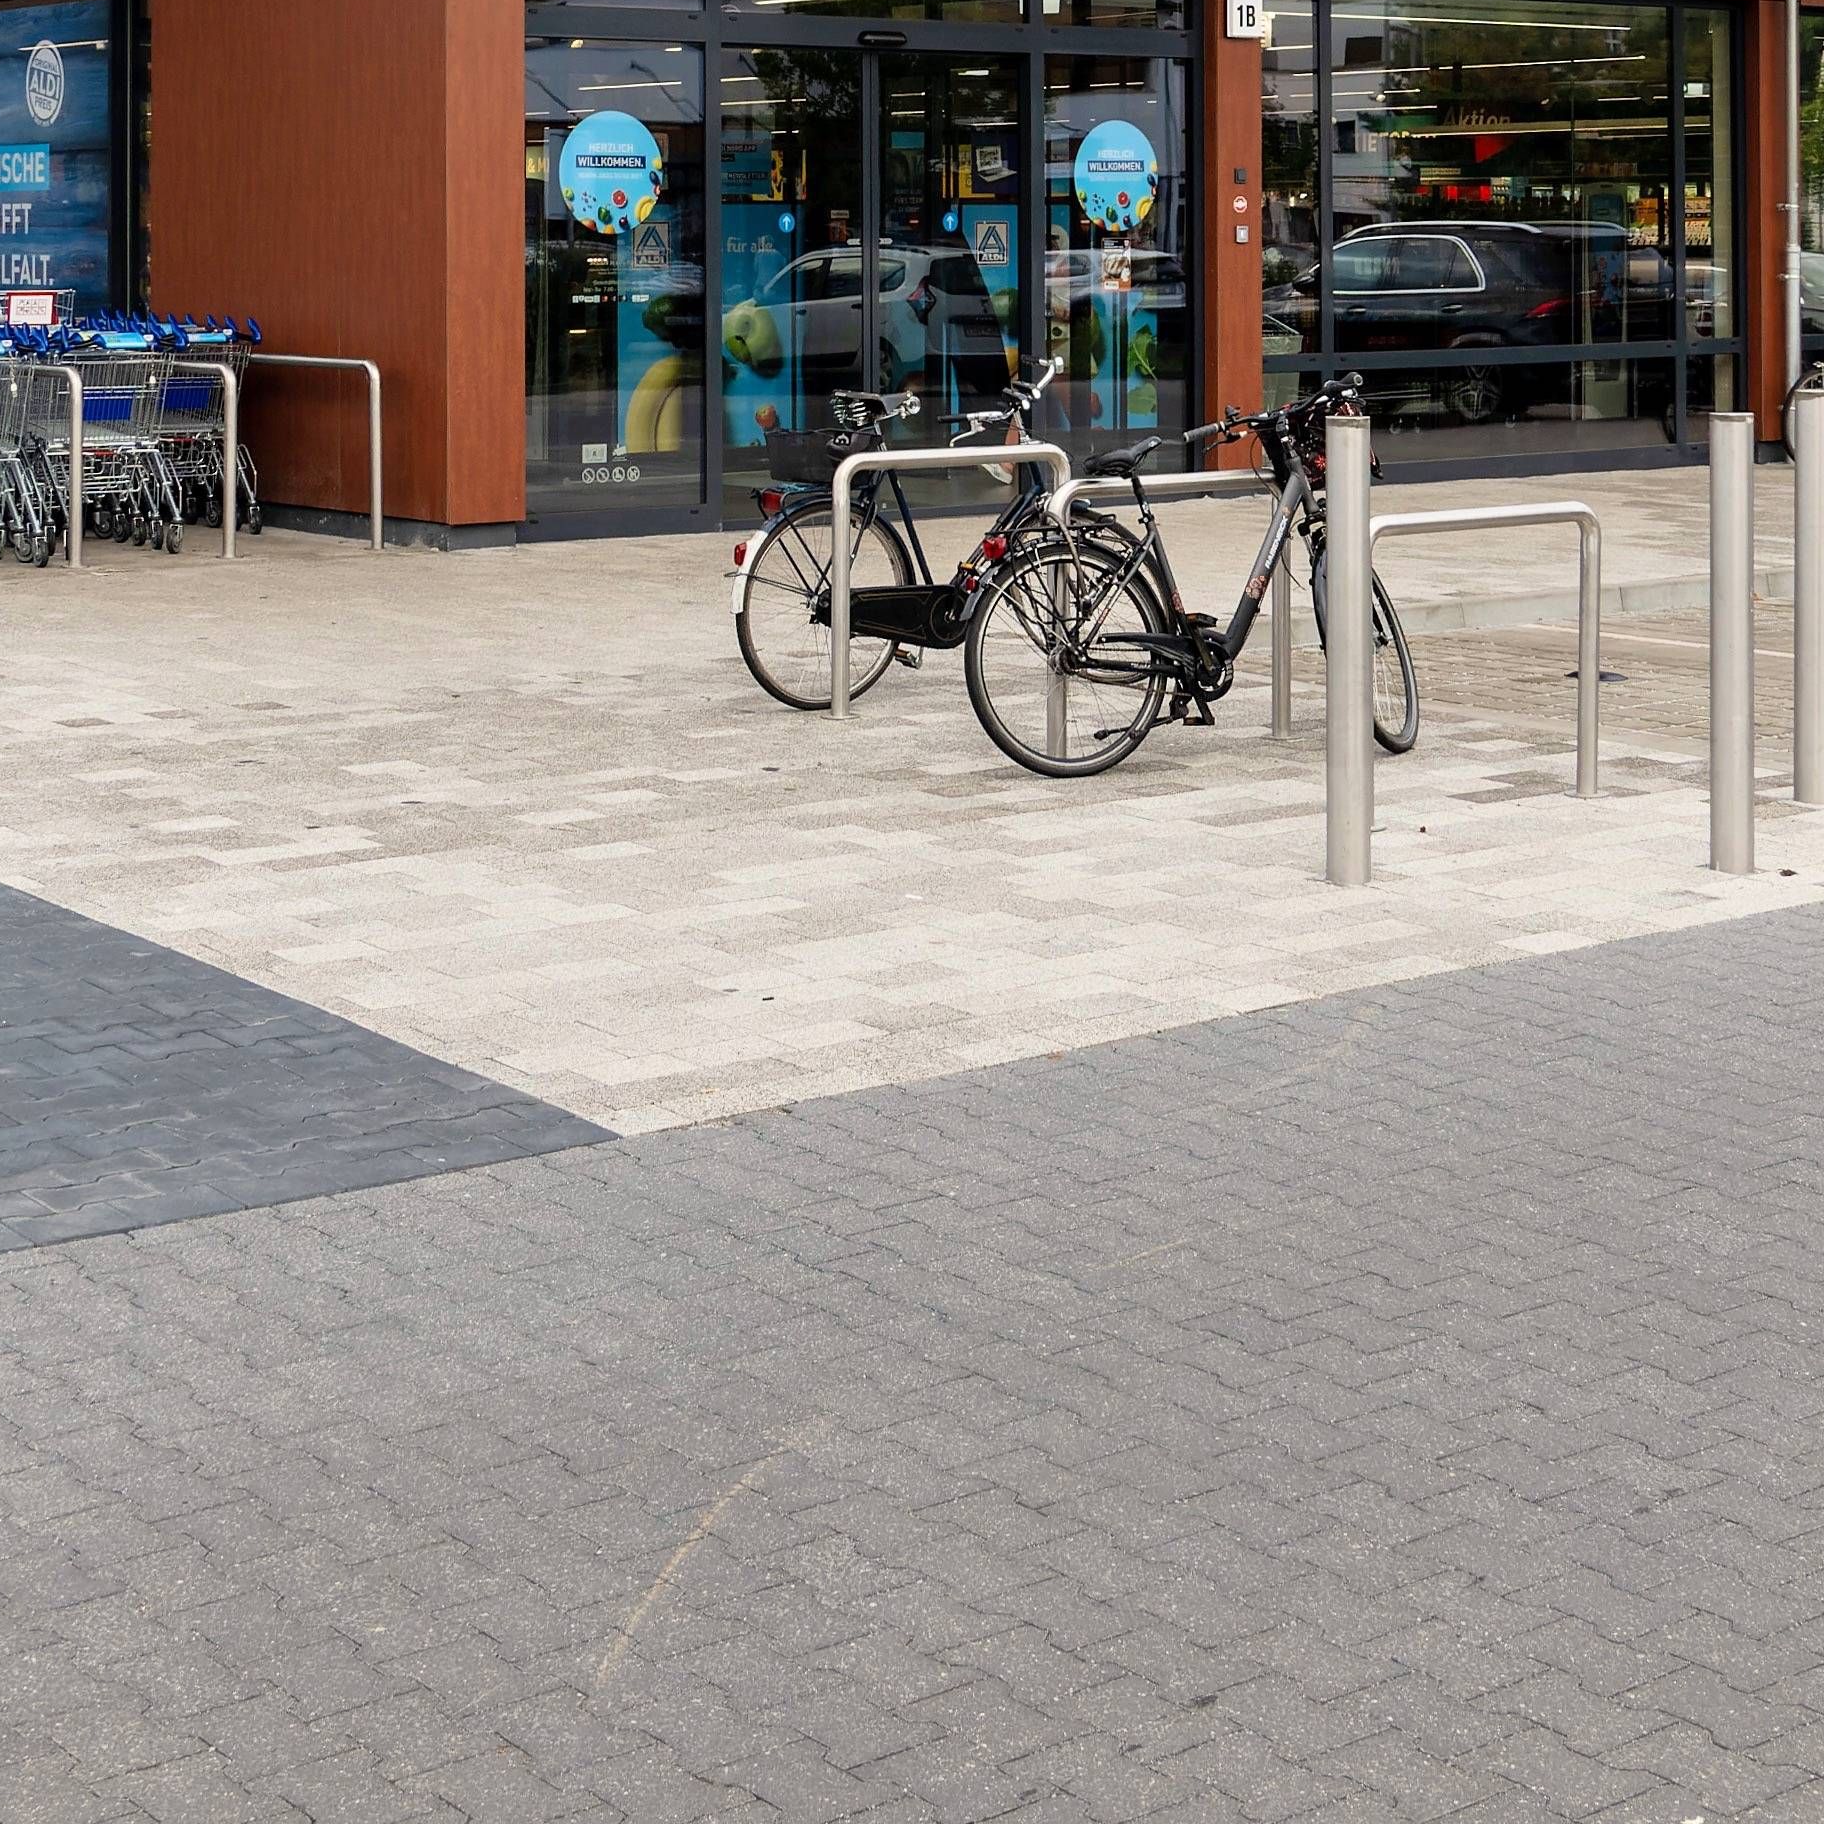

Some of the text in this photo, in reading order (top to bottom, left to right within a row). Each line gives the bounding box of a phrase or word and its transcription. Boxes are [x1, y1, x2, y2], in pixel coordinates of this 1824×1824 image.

[1236, 4, 1256, 28] 1B
[29, 70, 61, 99] ALDI
[34, 96, 52, 111] PREIS
[588, 143, 634, 153] HERZLICH
[577, 156, 644, 168] WILLKOMMEN.
[1089, 161, 1143, 171] WILLKOMMEN.
[638, 255, 664, 264] ALDI
[981, 252, 1004, 262] ALDI
